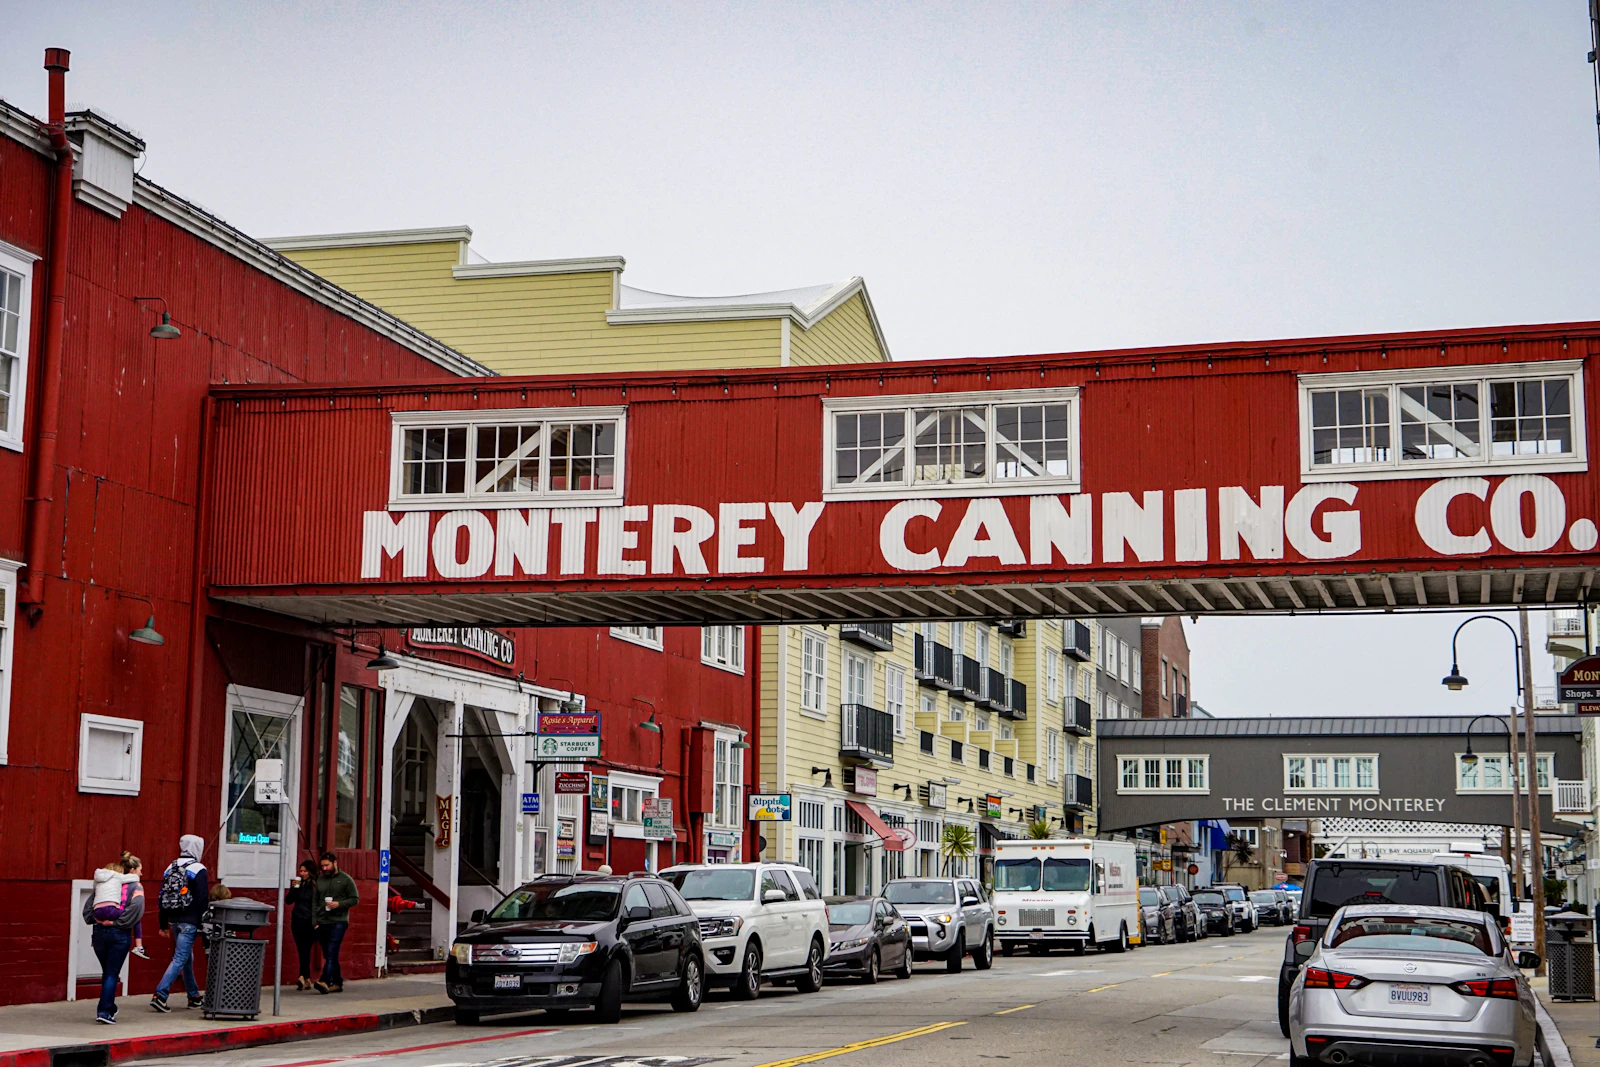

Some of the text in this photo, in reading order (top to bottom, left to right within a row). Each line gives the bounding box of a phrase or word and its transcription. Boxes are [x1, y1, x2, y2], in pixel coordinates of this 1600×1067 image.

[360, 474, 1599, 580] MONTEREY CANNING CO.
[412, 628, 513, 663] MONTEREY CANNING CO
[542, 715, 596, 726] Rosie's Apparel
[765, 805, 785, 813] dots
[1222, 798, 1446, 812] THE CLEMENT MONTEREY
[439, 799, 450, 847] MAGIC
[257, 833, 270, 844] Open
[1390, 990, 1429, 1002] 8VUU983
